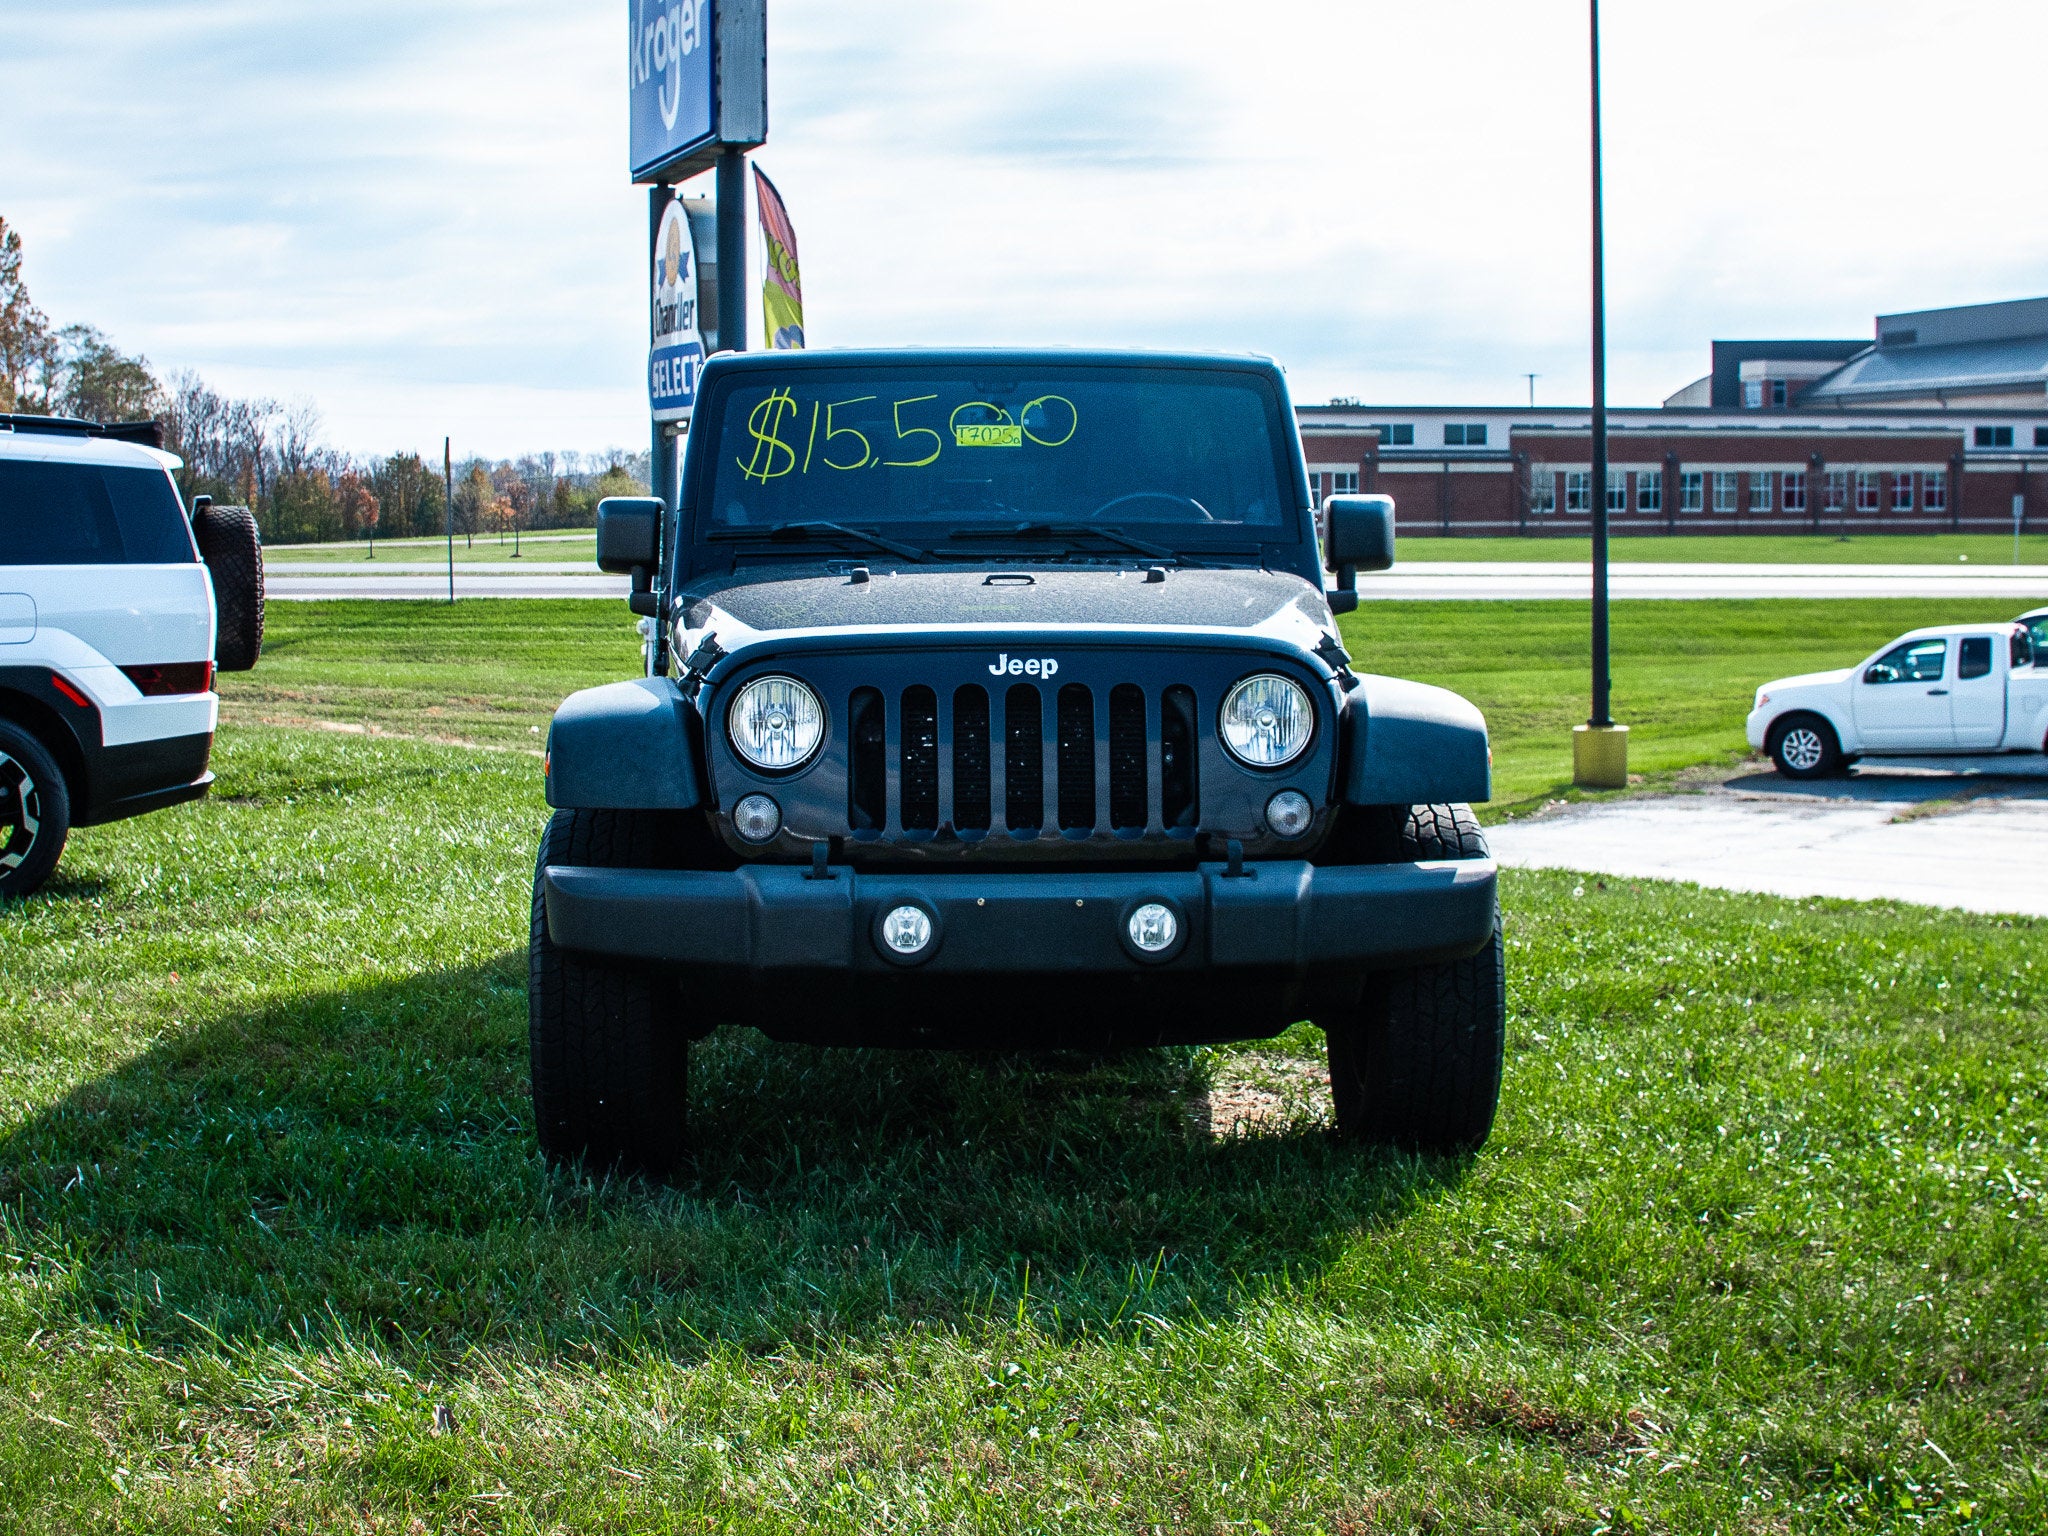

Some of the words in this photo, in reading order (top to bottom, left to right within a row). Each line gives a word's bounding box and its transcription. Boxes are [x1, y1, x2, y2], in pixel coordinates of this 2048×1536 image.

[655, 292, 695, 337] Chandler
[653, 354, 700, 398] SELECT
[736, 387, 1077, 485] $15,500
[988, 653, 1059, 680] Jeep
